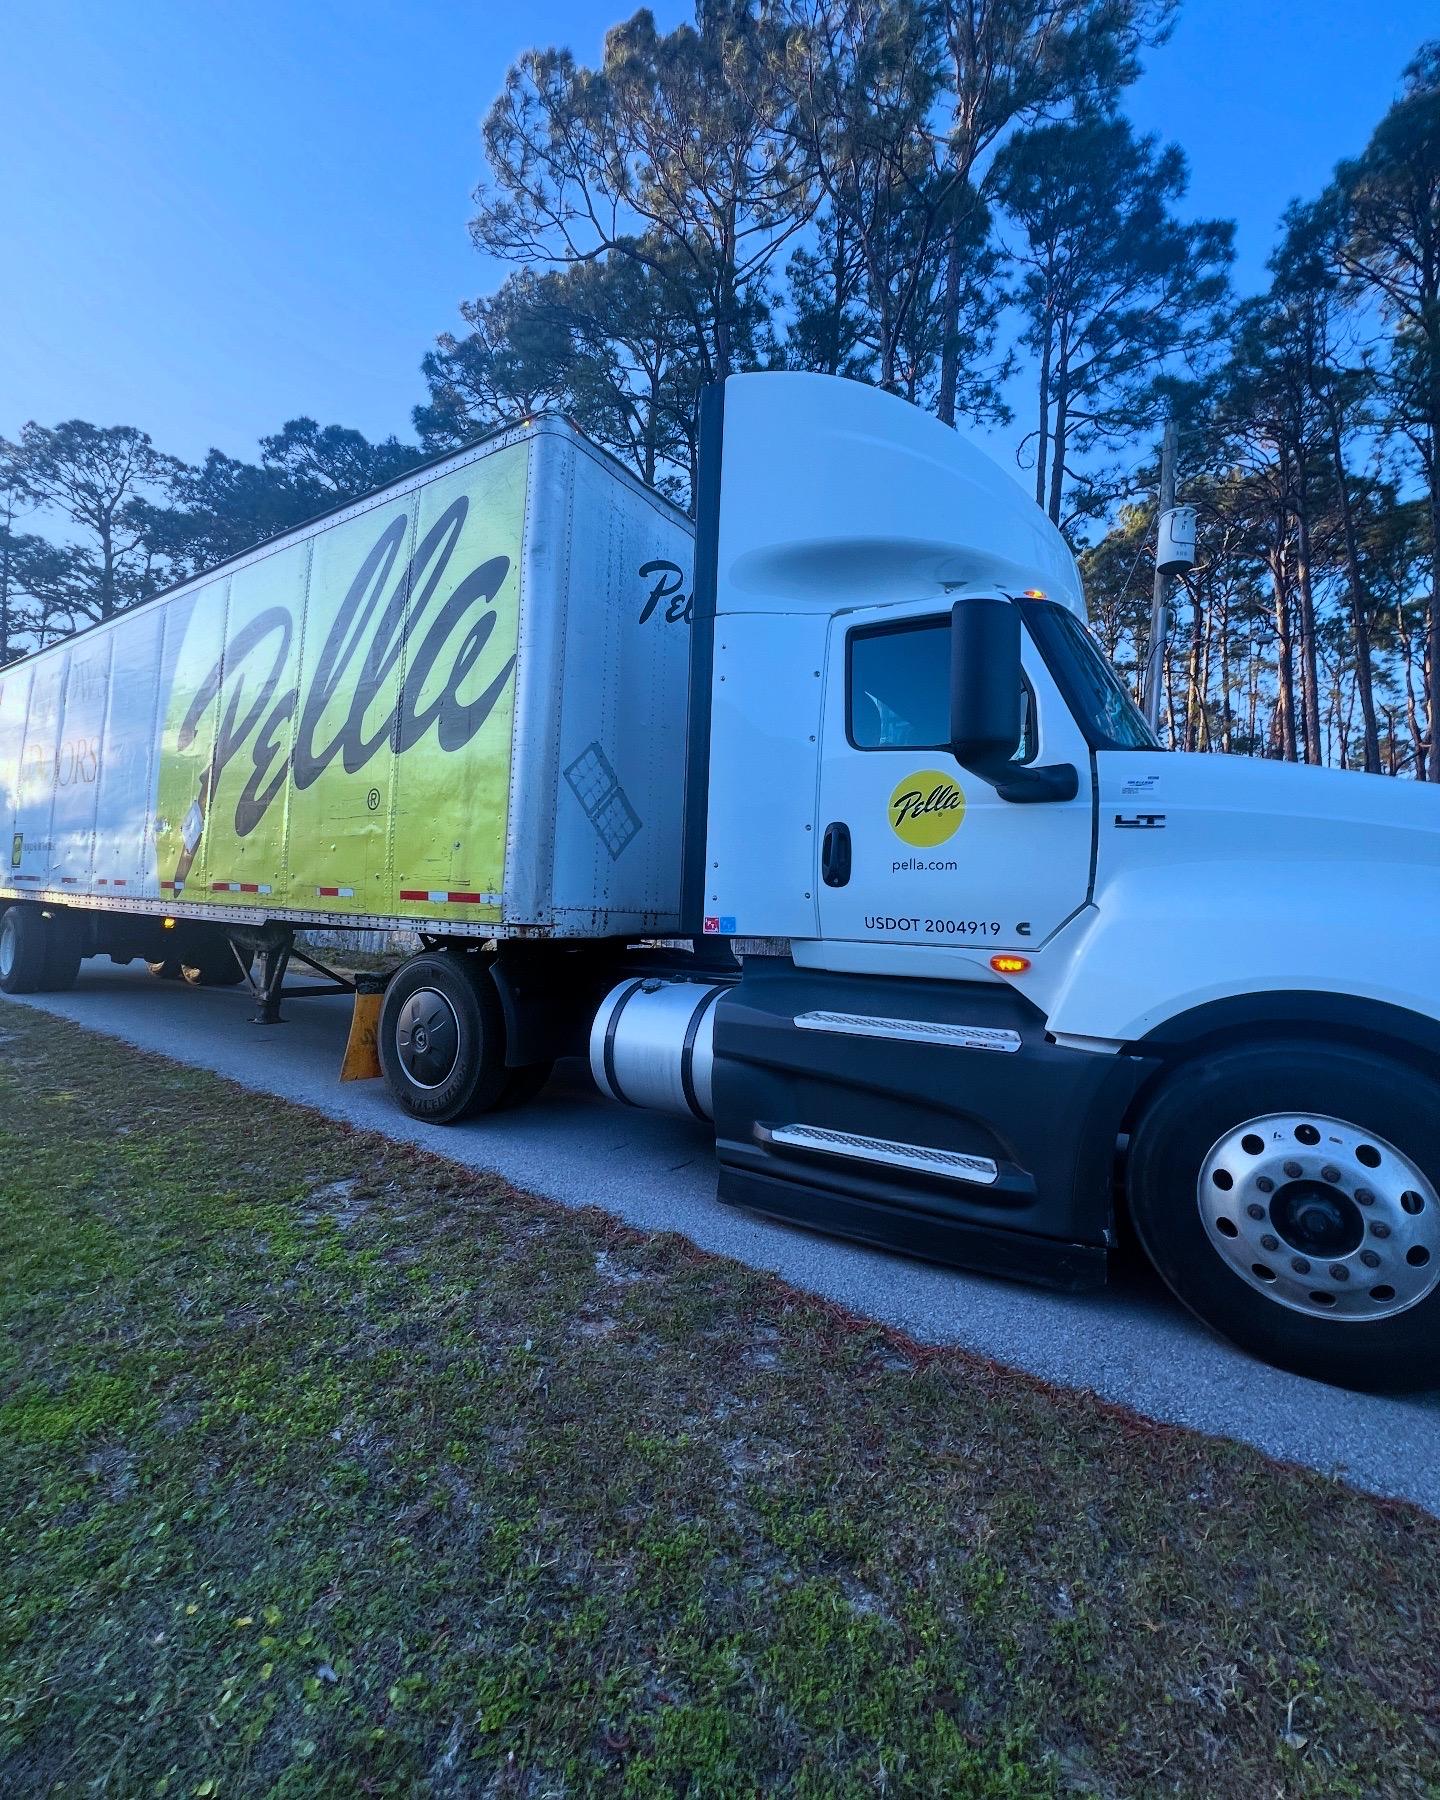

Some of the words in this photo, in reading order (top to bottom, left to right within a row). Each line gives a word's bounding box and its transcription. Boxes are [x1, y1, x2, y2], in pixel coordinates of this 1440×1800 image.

[639, 560, 693, 624] Pel
[173, 496, 516, 897] Pella
[894, 785, 960, 827] Pella
[1115, 814, 1166, 825] LT
[892, 858, 958, 873] pella.com
[865, 917, 920, 931] USDOT
[925, 920, 1001, 935] 2004919
